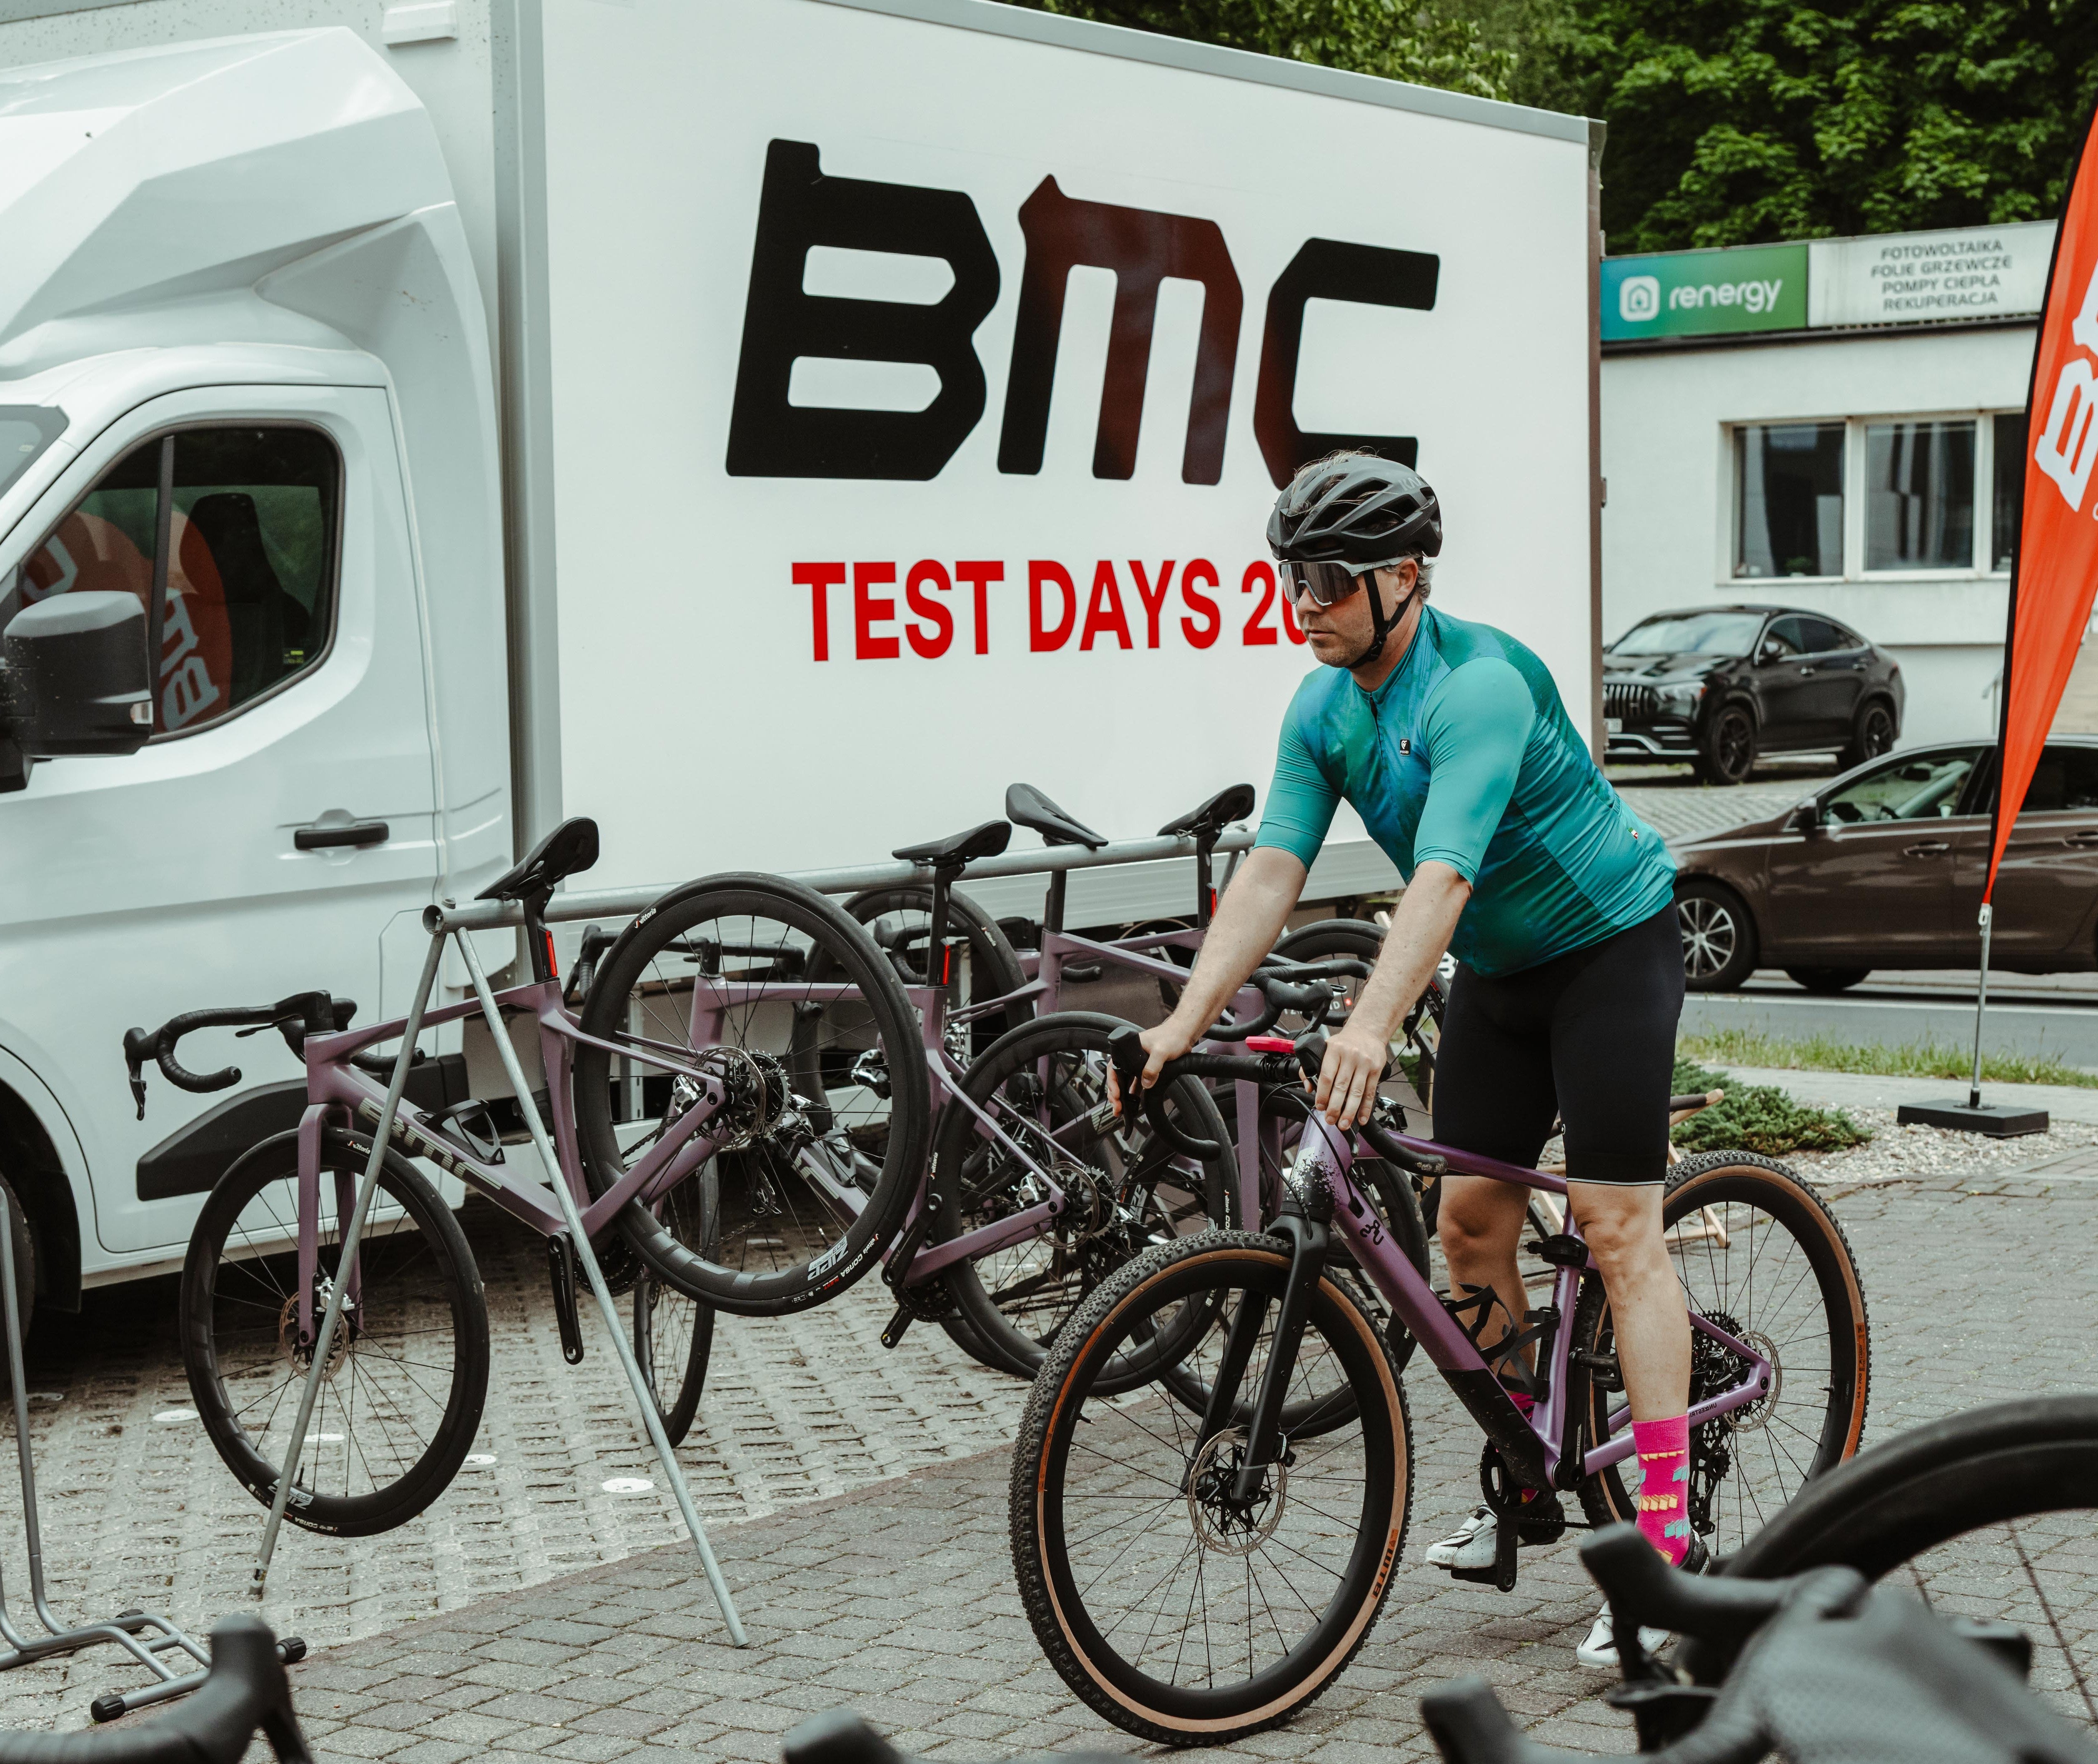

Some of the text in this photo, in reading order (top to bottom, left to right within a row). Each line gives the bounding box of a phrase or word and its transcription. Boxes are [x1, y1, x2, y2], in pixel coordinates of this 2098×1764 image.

[1880, 239, 2003, 260] FOTOWOLTAIKA
[1870, 255, 2012, 278] FOLIE GRZEWCZE
[1669, 279, 1783, 314] renergy
[1882, 278, 1939, 294] POMPY
[1883, 292, 1998, 311] REKUPERACJA
[726, 138, 1440, 490] BMC
[791, 559, 1005, 662] TEST
[1027, 557, 1221, 652] DAYS
[639, 908, 657, 924] vittoria
[862, 1238, 875, 1254] vittoria
[807, 1244, 849, 1281] ZIPP
[840, 1253, 863, 1277] CORSA
[295, 1517, 318, 1528] CORSA
[1372, 1548, 1394, 1598] WTB
